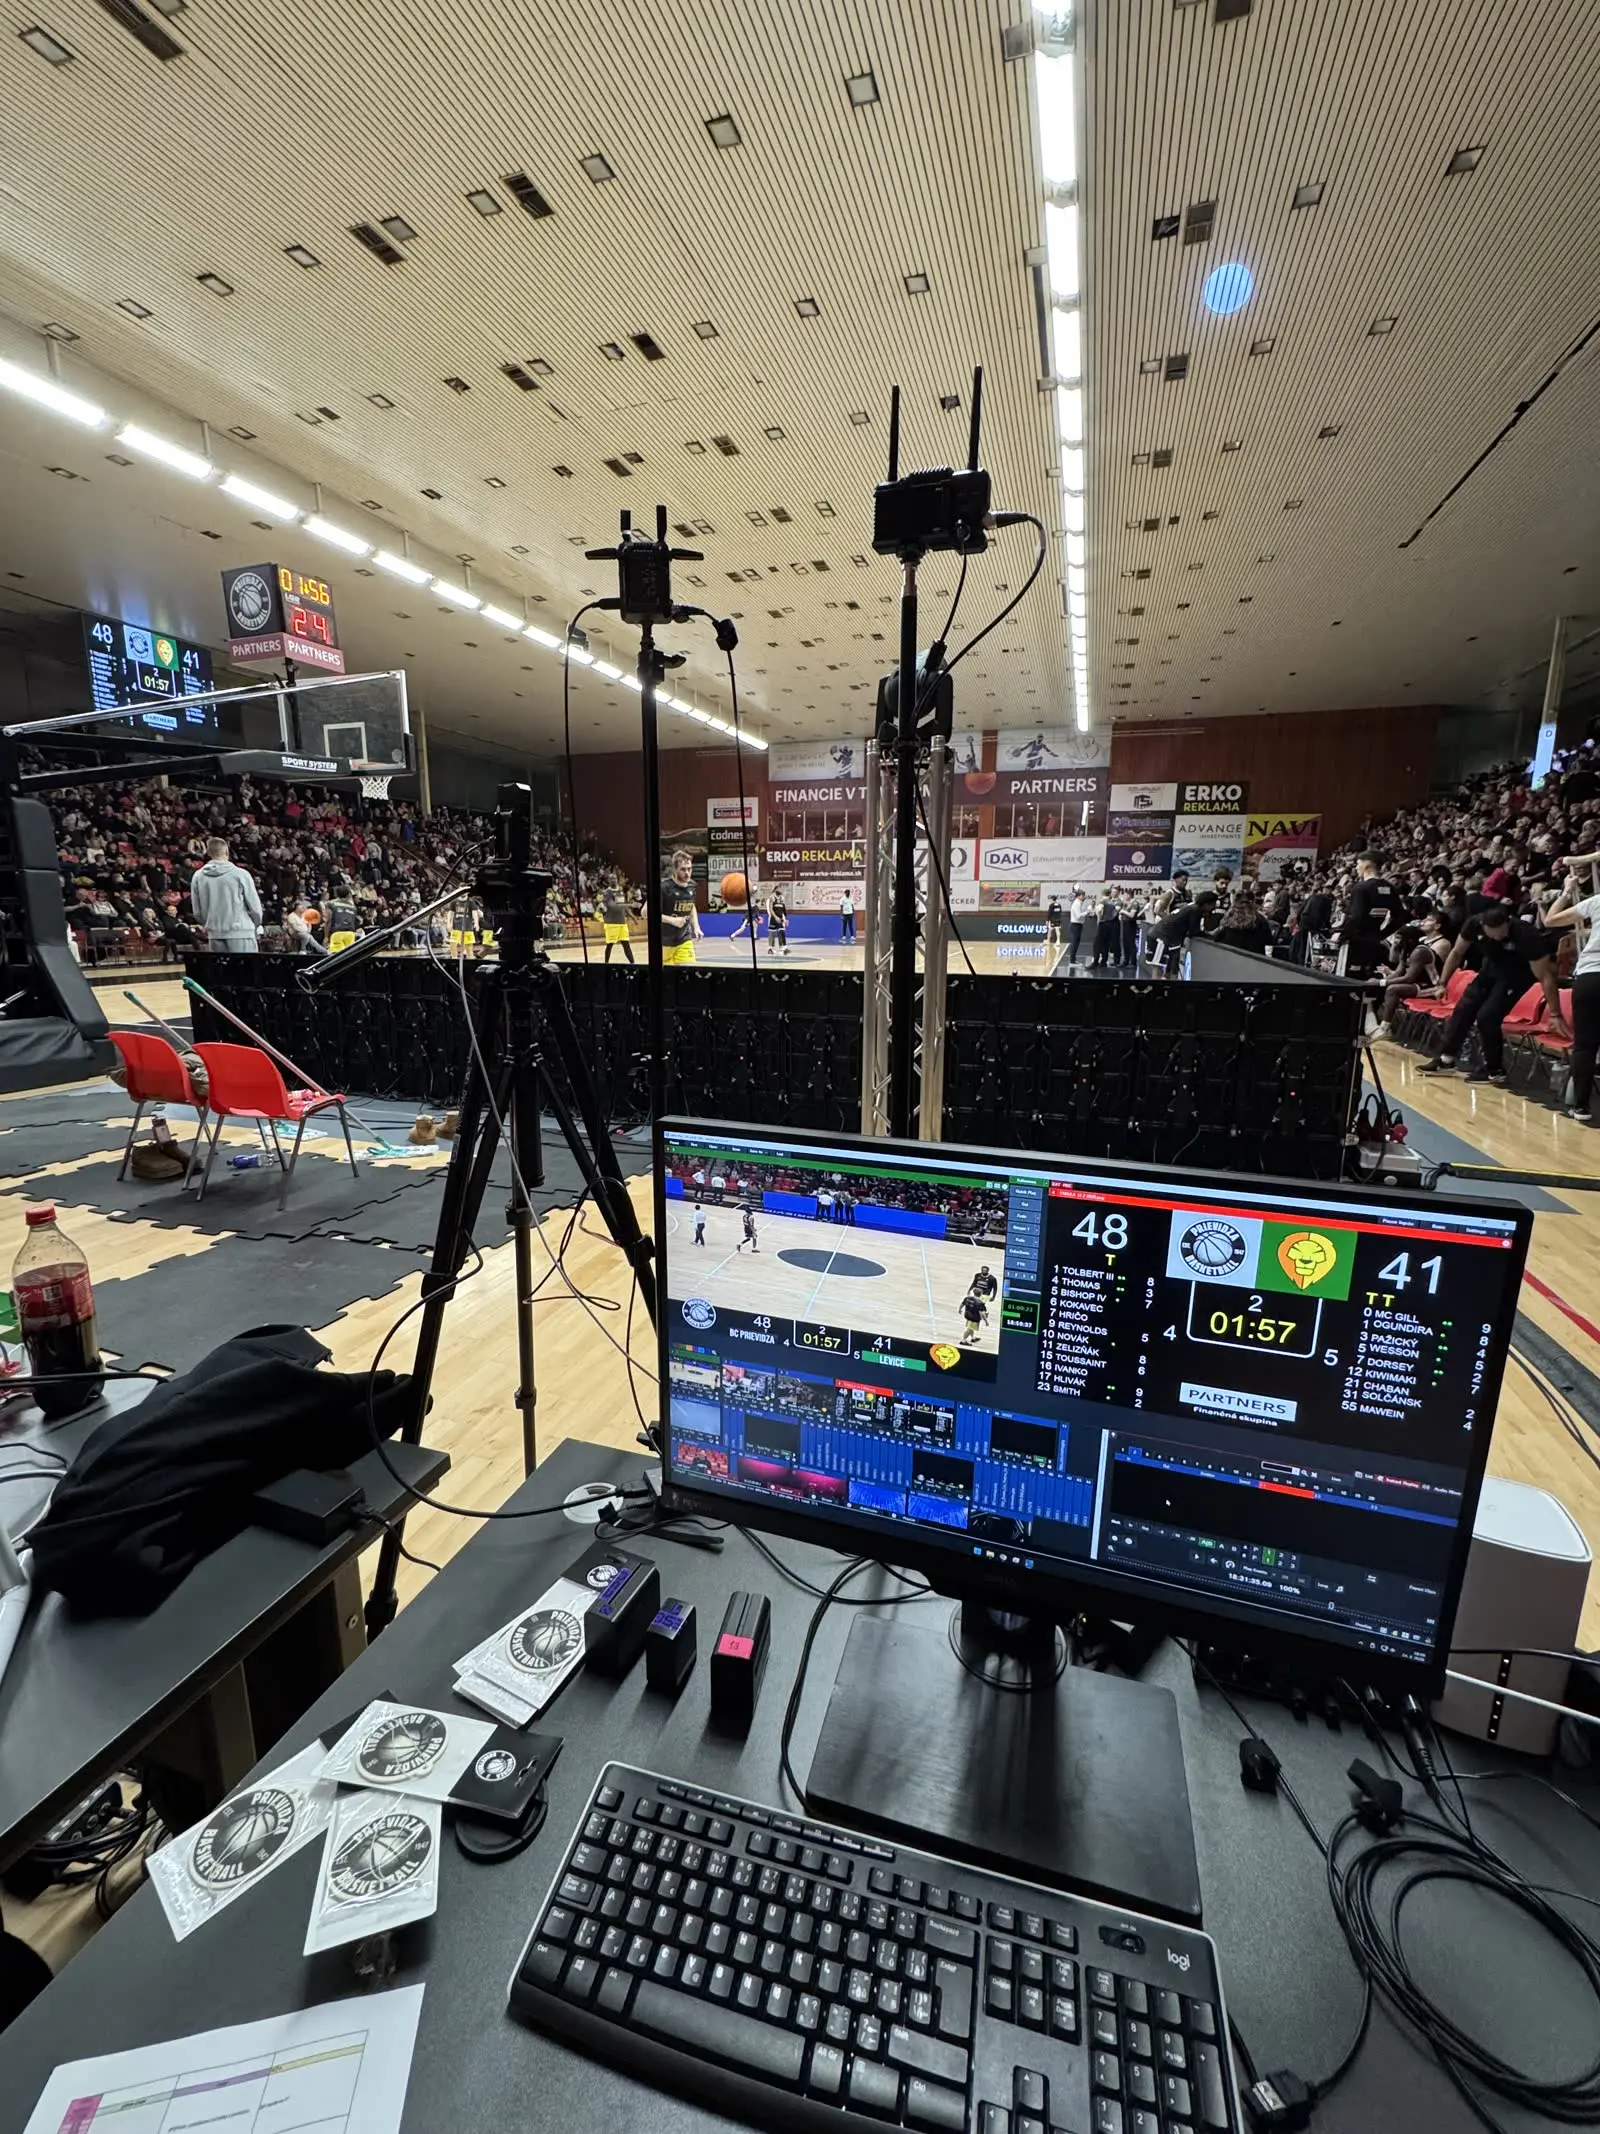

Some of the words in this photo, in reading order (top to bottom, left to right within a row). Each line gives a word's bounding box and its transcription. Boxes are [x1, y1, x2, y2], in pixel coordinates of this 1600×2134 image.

[293, 605, 328, 641] 24
[92, 622, 113, 644] 48
[232, 640, 281, 656] PARTNERS
[288, 640, 341, 666] PARTNERS
[183, 650, 200, 669] 41
[153, 668, 159, 677] 2
[144, 675, 170, 692] 01:57
[281, 756, 308, 767] SPORT
[308, 760, 338, 770] SYSTEM
[1010, 778, 1097, 794] PARTNERS
[1185, 784, 1242, 801] ERKO
[775, 787, 842, 802] FINANCIE
[845, 787, 856, 800] V
[1183, 802, 1240, 812] REKLAMA
[1248, 820, 1318, 836] NAVI
[766, 850, 800, 862] ERKO
[802, 849, 863, 862] REKLAMA
[989, 853, 1023, 865] DAK
[1124, 865, 1163, 874] NICOLAUS
[997, 925, 1034, 934] FOLLOW
[1035, 925, 1047, 934] US
[1072, 1211, 1129, 1250] 48
[1191, 1220, 1240, 1242] PRIEVIDZA
[1184, 1255, 1239, 1277] BASKETBALL
[1378, 1252, 1443, 1294] 41
[1053, 1265, 1060, 1274] 1
[1063, 1266, 1104, 1279] TOLBERT
[1105, 1272, 1114, 1281] III
[1147, 1277, 1155, 1287] 8
[1051, 1276, 1059, 1285] 4
[1062, 1277, 1101, 1290] THOMAS
[1145, 1288, 1154, 1298] 3
[1050, 1297, 1057, 1307] 6
[1059, 1299, 1104, 1313] KOKAVEC
[1051, 1287, 1058, 1296] 5
[1060, 1288, 1095, 1301] BISHOP
[1097, 1294, 1107, 1302] IV
[1144, 1299, 1153, 1310] 7
[1247, 1294, 1263, 1312] 2
[753, 1315, 771, 1329] 48
[1049, 1308, 1057, 1317] 7
[1059, 1309, 1089, 1322] HRIČO
[1374, 1309, 1392, 1320] MC
[1395, 1312, 1419, 1324] GILL
[1481, 1323, 1491, 1334] 9
[819, 1326, 826, 1335] 2
[1048, 1319, 1056, 1328] 9
[1058, 1320, 1108, 1336] REYNOLDS
[1141, 1333, 1149, 1343] 5
[1163, 1325, 1177, 1341] 4
[1210, 1311, 1296, 1344] 01:57
[1362, 1319, 1369, 1329] 1
[1373, 1319, 1434, 1336] OGUNDIRA
[1479, 1336, 1489, 1346] 8
[729, 1328, 740, 1338] BC
[740, 1330, 775, 1345] PRIEVIDZA
[783, 1339, 790, 1347] 4
[803, 1333, 841, 1349] 01:57
[873, 1336, 892, 1350] 41
[1042, 1329, 1055, 1339] 10
[1057, 1330, 1089, 1344] NOVÁK
[1042, 1340, 1053, 1349] 11
[1139, 1355, 1147, 1365] 8
[1360, 1331, 1368, 1341] 3
[1370, 1333, 1419, 1348] PAŽICKÝ
[1476, 1348, 1486, 1359] 4
[853, 1350, 861, 1360] 5
[879, 1355, 905, 1368] LEVICE
[1040, 1350, 1053, 1360] 15
[1055, 1353, 1107, 1368] TOUSSAINT
[1137, 1366, 1146, 1376] 6
[1323, 1349, 1339, 1366] 5
[1357, 1343, 1367, 1353] 5
[1369, 1343, 1420, 1359] WESSON
[1474, 1361, 1484, 1371] 5
[1039, 1361, 1052, 1371] 16
[1054, 1363, 1088, 1377] IVANKO
[1356, 1355, 1365, 1365] 7
[1367, 1357, 1415, 1372] DORSEY
[1471, 1372, 1482, 1384] 2
[1039, 1371, 1050, 1381] 17
[1053, 1373, 1086, 1387] HLIVÁK
[1135, 1387, 1143, 1398] 9
[1344, 1377, 1360, 1388] 21
[1363, 1381, 1410, 1396] CHABAN
[1347, 1366, 1363, 1377] 12
[1365, 1369, 1417, 1385] KIWIMAKI
[1470, 1384, 1480, 1395] 7
[1037, 1381, 1051, 1392] 23
[1053, 1384, 1081, 1397] SMITH
[1134, 1398, 1142, 1409] 2
[1187, 1389, 1286, 1414] PARTNERS
[1343, 1389, 1358, 1400] 31
[1361, 1390, 1422, 1408] SOLČÁNSK
[1465, 1408, 1475, 1419] 2
[1238, 1414, 1278, 1427] skupina
[1341, 1400, 1358, 1412] 55
[1359, 1403, 1405, 1420] MAWEIN
[1463, 1421, 1472, 1431] 4
[551, 1610, 581, 1647] PRIEVIDZA
[512, 1627, 545, 1668] BASKETBALL
[362, 1714, 426, 1756] BASKETBALL
[383, 1736, 444, 1777] PRIEVIDZA
[251, 1790, 289, 1836] PRIEVIDZA
[194, 1828, 245, 1880] BASKETBALL
[690, 1880, 698, 1891] R
[717, 1888, 724, 1899] T
[608, 1890, 616, 1900] A
[743, 1896, 750, 1908] Y
[659, 1906, 667, 1917] D
[769, 1906, 777, 1919] U
[685, 1916, 693, 1927] F
[537, 1944, 548, 1953] Ctrl
[767, 1943, 775, 1955] J
[689, 1956, 697, 1968] V
[1167, 1947, 1191, 1972] logi
[609, 1971, 618, 1979] Alt
[1130, 2022, 1137, 2033] 8
[1164, 2032, 1171, 2044] 9
[1134, 2066, 1140, 2077] 5
[1168, 2078, 1175, 2089] 6
[1137, 2112, 1144, 2125] 2
